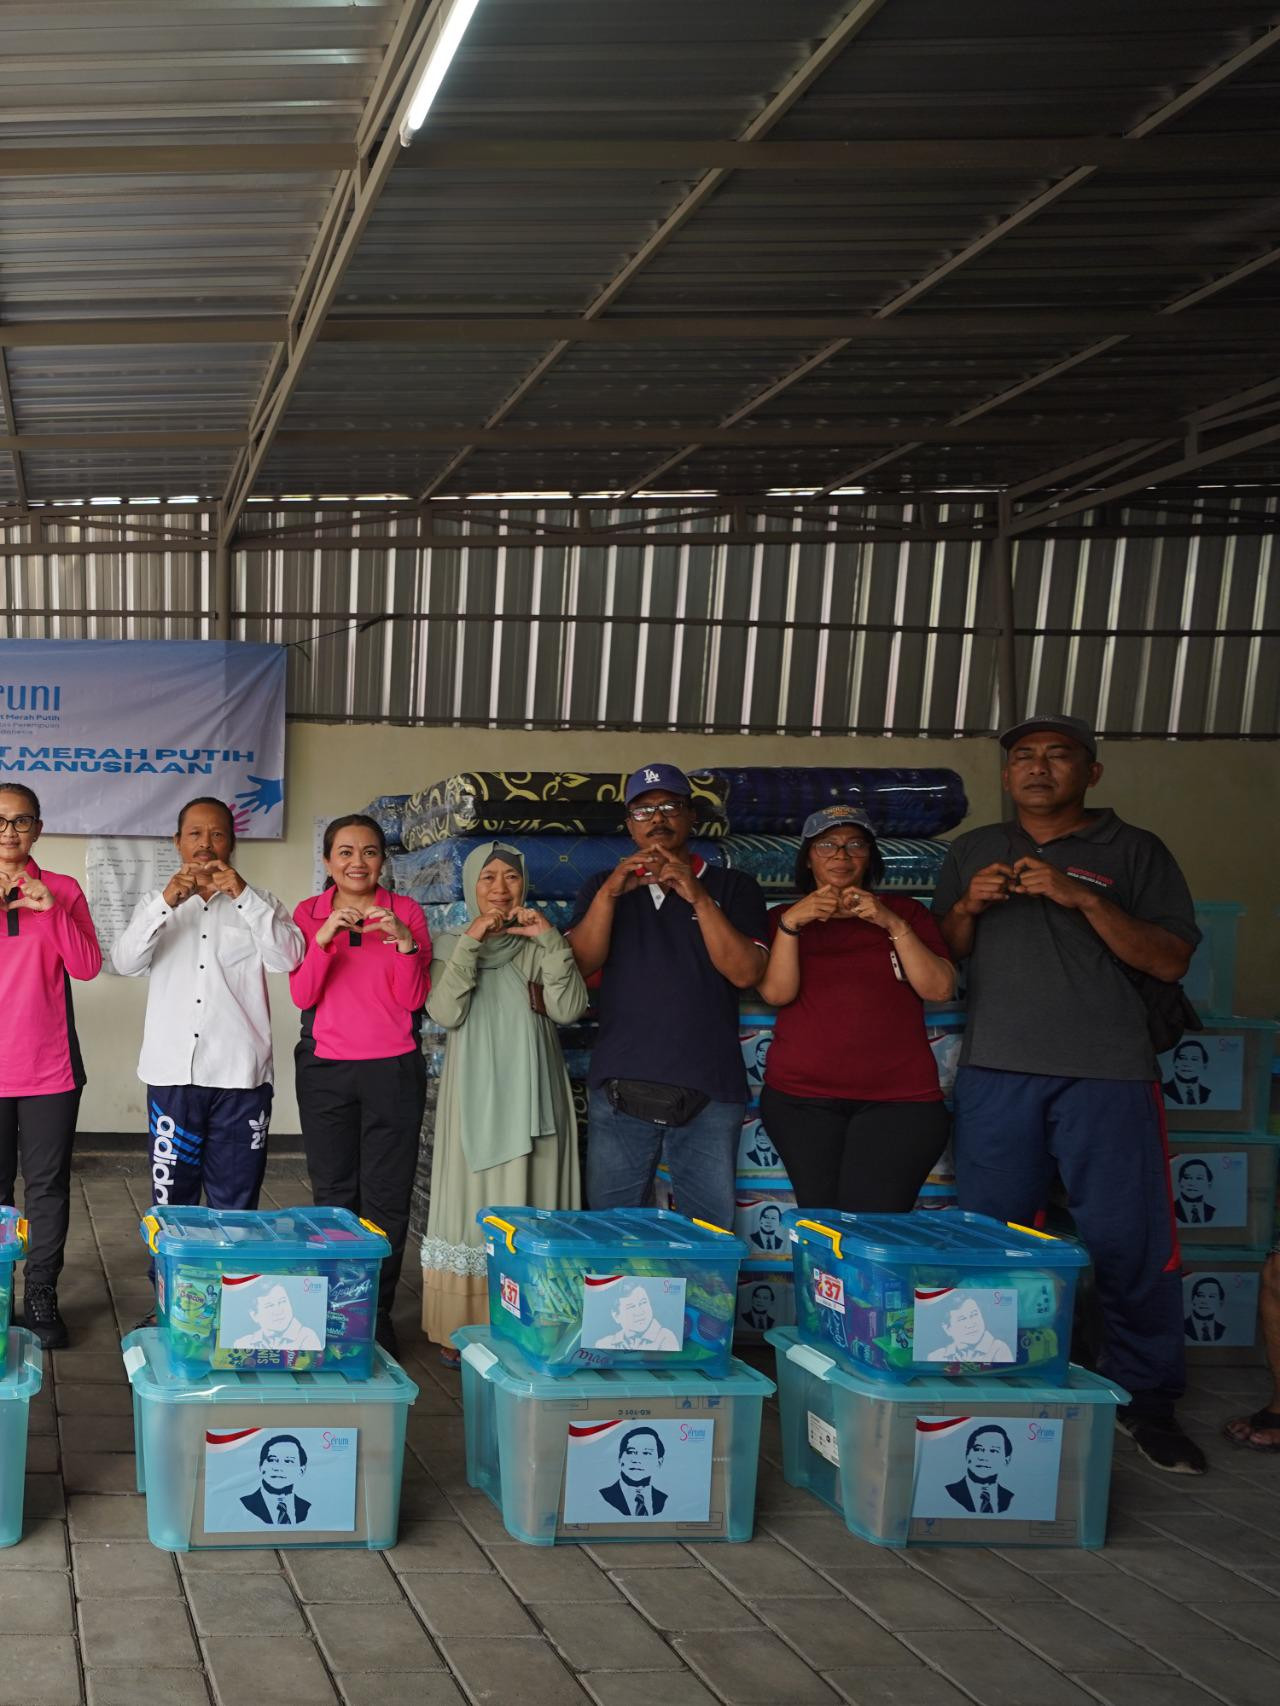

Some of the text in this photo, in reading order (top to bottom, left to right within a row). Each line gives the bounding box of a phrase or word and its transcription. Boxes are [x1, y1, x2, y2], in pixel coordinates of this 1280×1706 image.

[6, 713, 35, 721] Merah
[20, 746, 148, 760] MERAH
[155, 749, 254, 762] PUTIH
[643, 768, 661, 784] LA
[152, 1115, 178, 1205] adida
[506, 1284, 518, 1306] 37
[823, 1279, 841, 1301] 37
